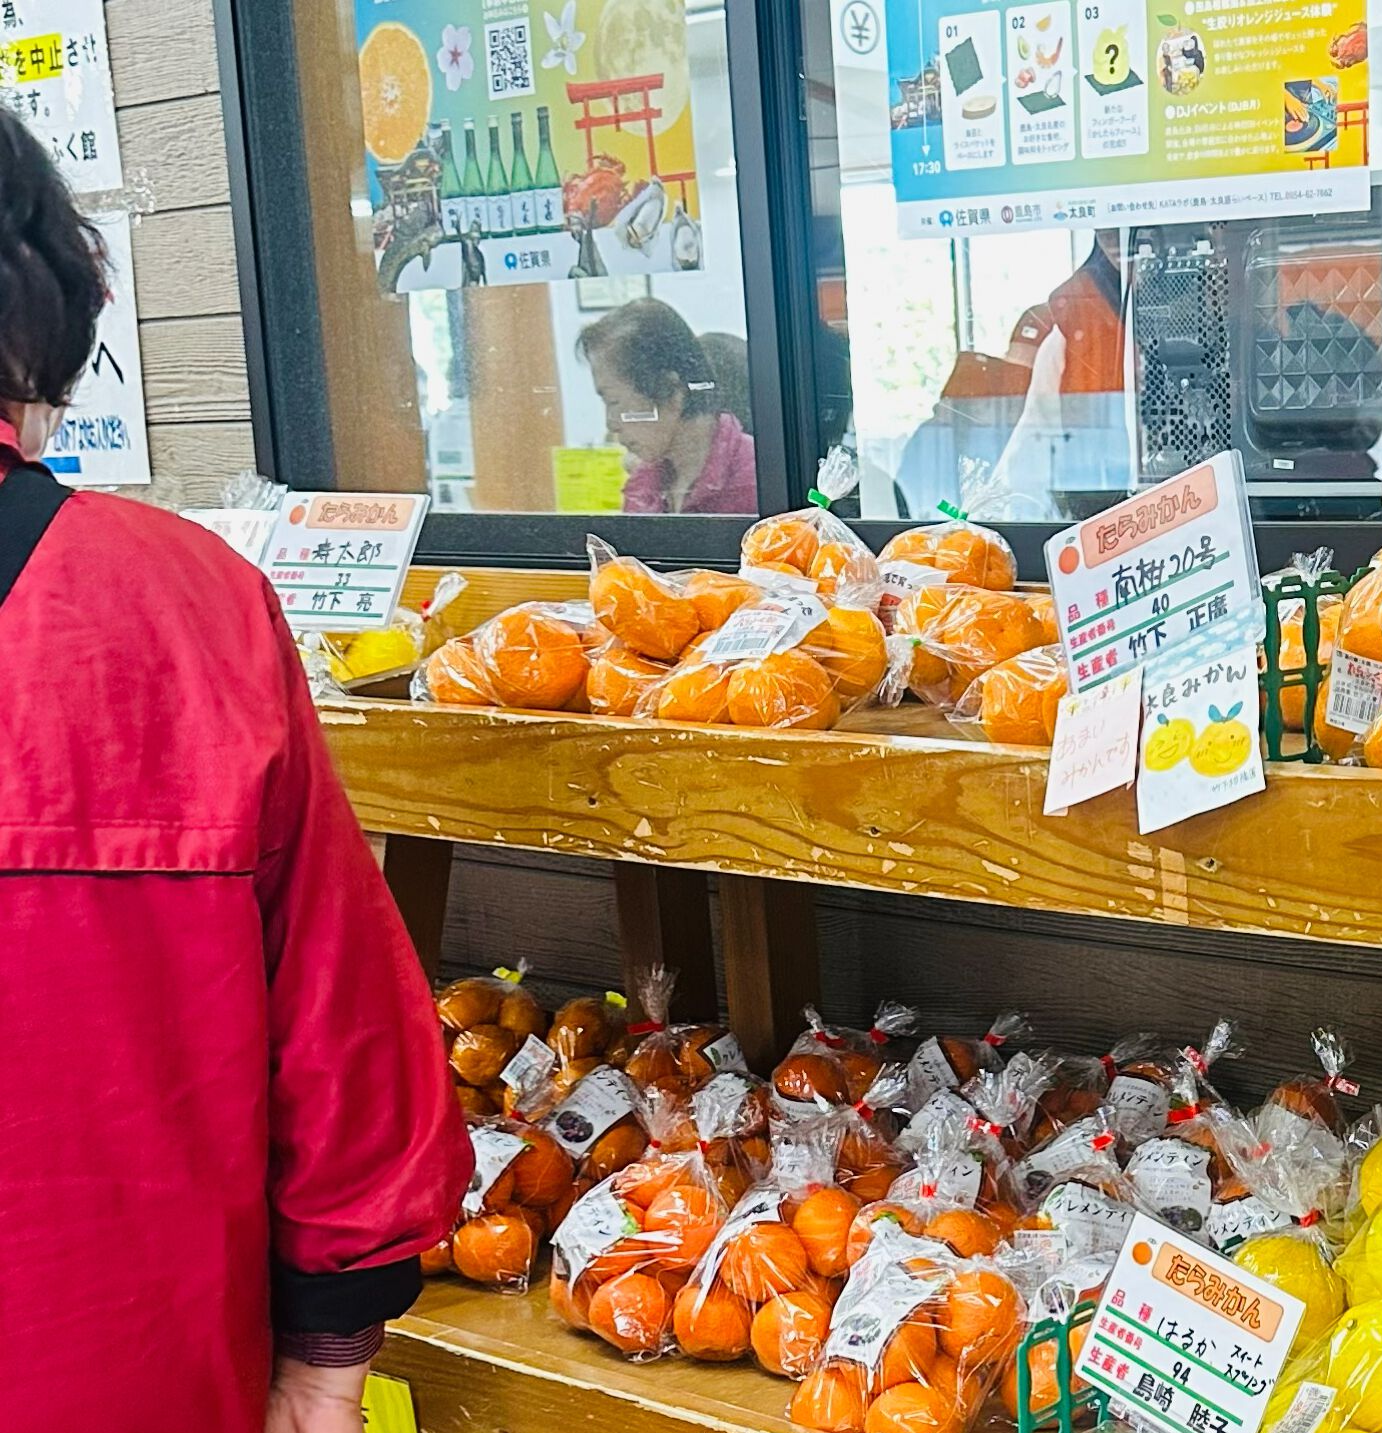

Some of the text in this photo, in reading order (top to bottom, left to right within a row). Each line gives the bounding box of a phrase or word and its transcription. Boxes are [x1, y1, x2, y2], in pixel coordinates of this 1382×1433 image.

[1012, 17, 1025, 29] 02
[1085, 7, 1099, 20] 03
[946, 26, 958, 38] 01
[913, 161, 941, 176] 17:30
[956, 208, 992, 227] 佐賀県
[519, 249, 552, 269] 佐賀県
[317, 502, 398, 525] たらみかん
[1095, 483, 1202, 555] たらみかん
[311, 590, 343, 611] 竹下
[1151, 592, 1170, 616] 40
[1077, 647, 1119, 682] 生産者
[1128, 621, 1167, 659] 竹下
[1165, 1253, 1262, 1330] たらみかん
[1155, 1316, 1217, 1358] はるか
[1098, 1316, 1192, 1385] 生産者番号 94
[1088, 1345, 1131, 1381] 生産者
